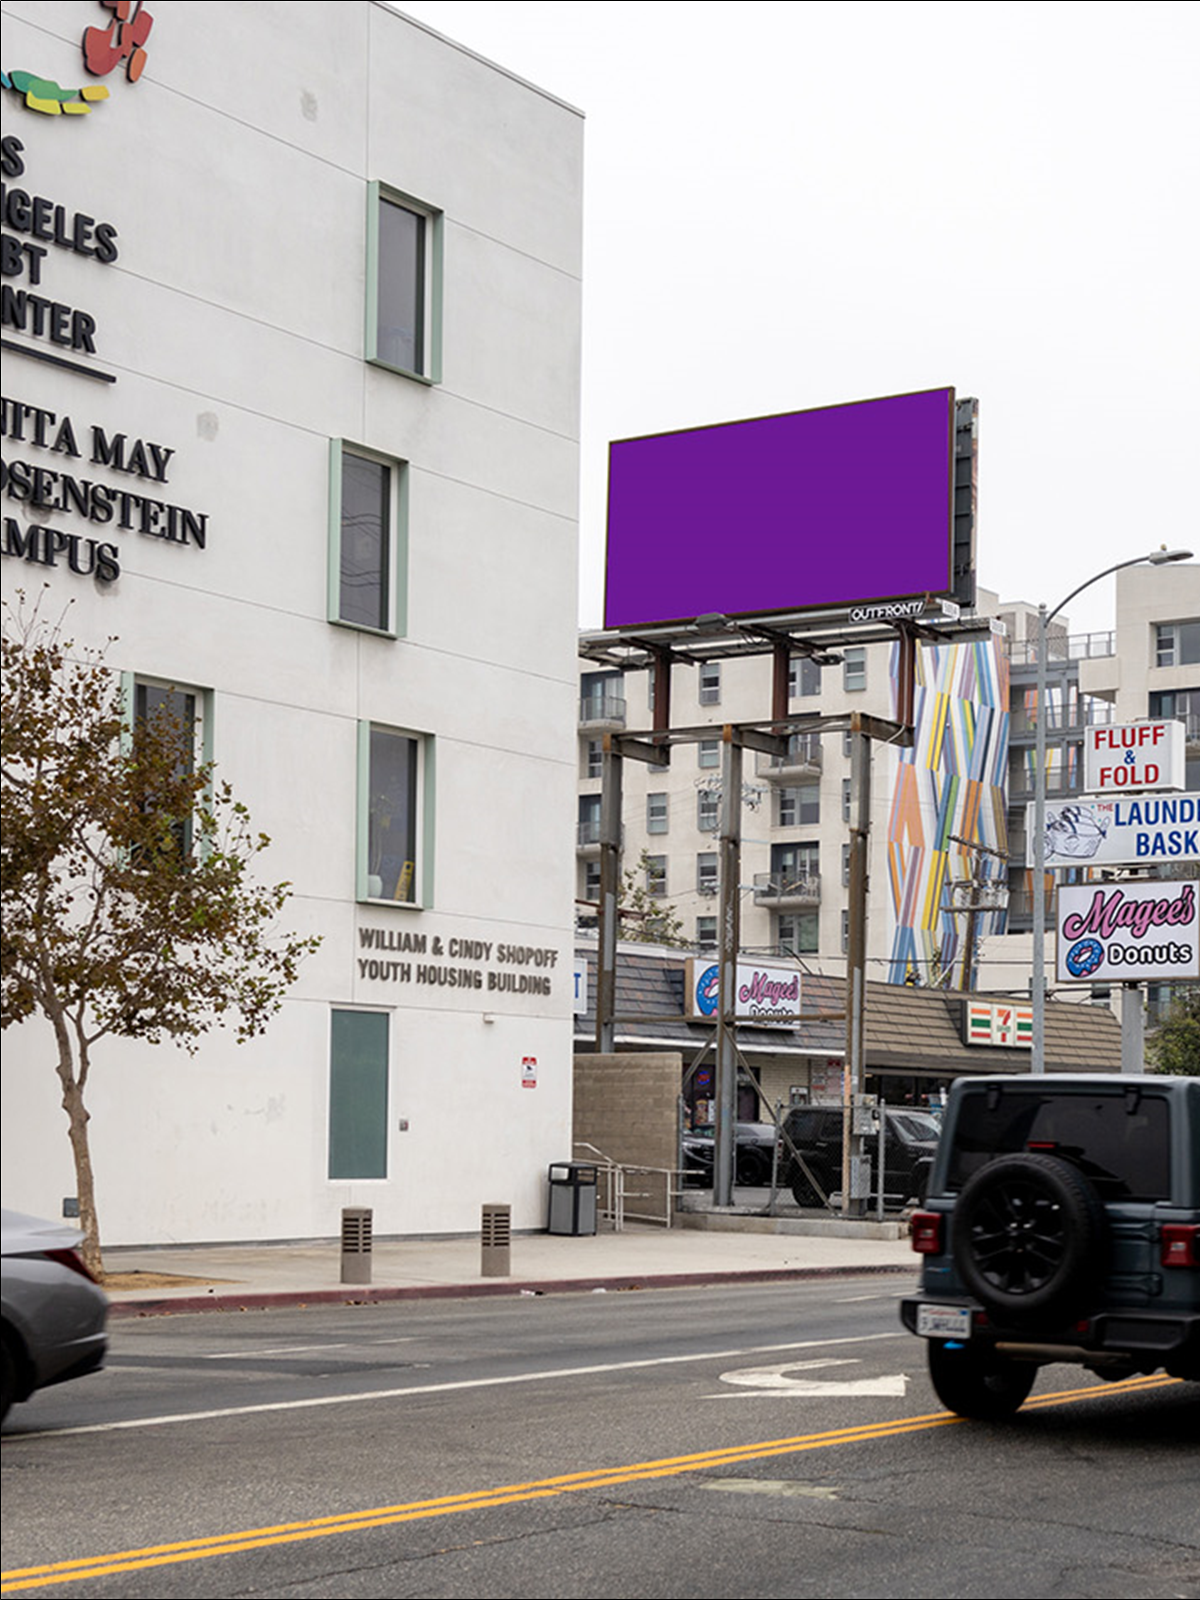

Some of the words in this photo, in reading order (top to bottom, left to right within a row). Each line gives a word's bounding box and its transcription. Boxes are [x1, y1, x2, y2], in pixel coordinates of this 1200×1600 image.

[2, 183, 119, 264] GELES
[90, 425, 175, 484] MAY
[2, 517, 121, 582] MPUS
[1094, 725, 1165, 750] FLUFF
[1100, 764, 1160, 787] FOLD
[1123, 749, 1136, 765] &
[1097, 803, 1113, 812] THE
[1063, 885, 1195, 940] Magee's
[358, 927, 427, 955] WILLIAM
[431, 935, 444, 956] &
[448, 938, 493, 962] CINDY
[496, 943, 559, 968] SHOPOFF
[1107, 942, 1193, 966] Donuts
[357, 958, 412, 984] YOUTH
[415, 963, 482, 990] HOUSING
[486, 971, 552, 996] BUILDING
